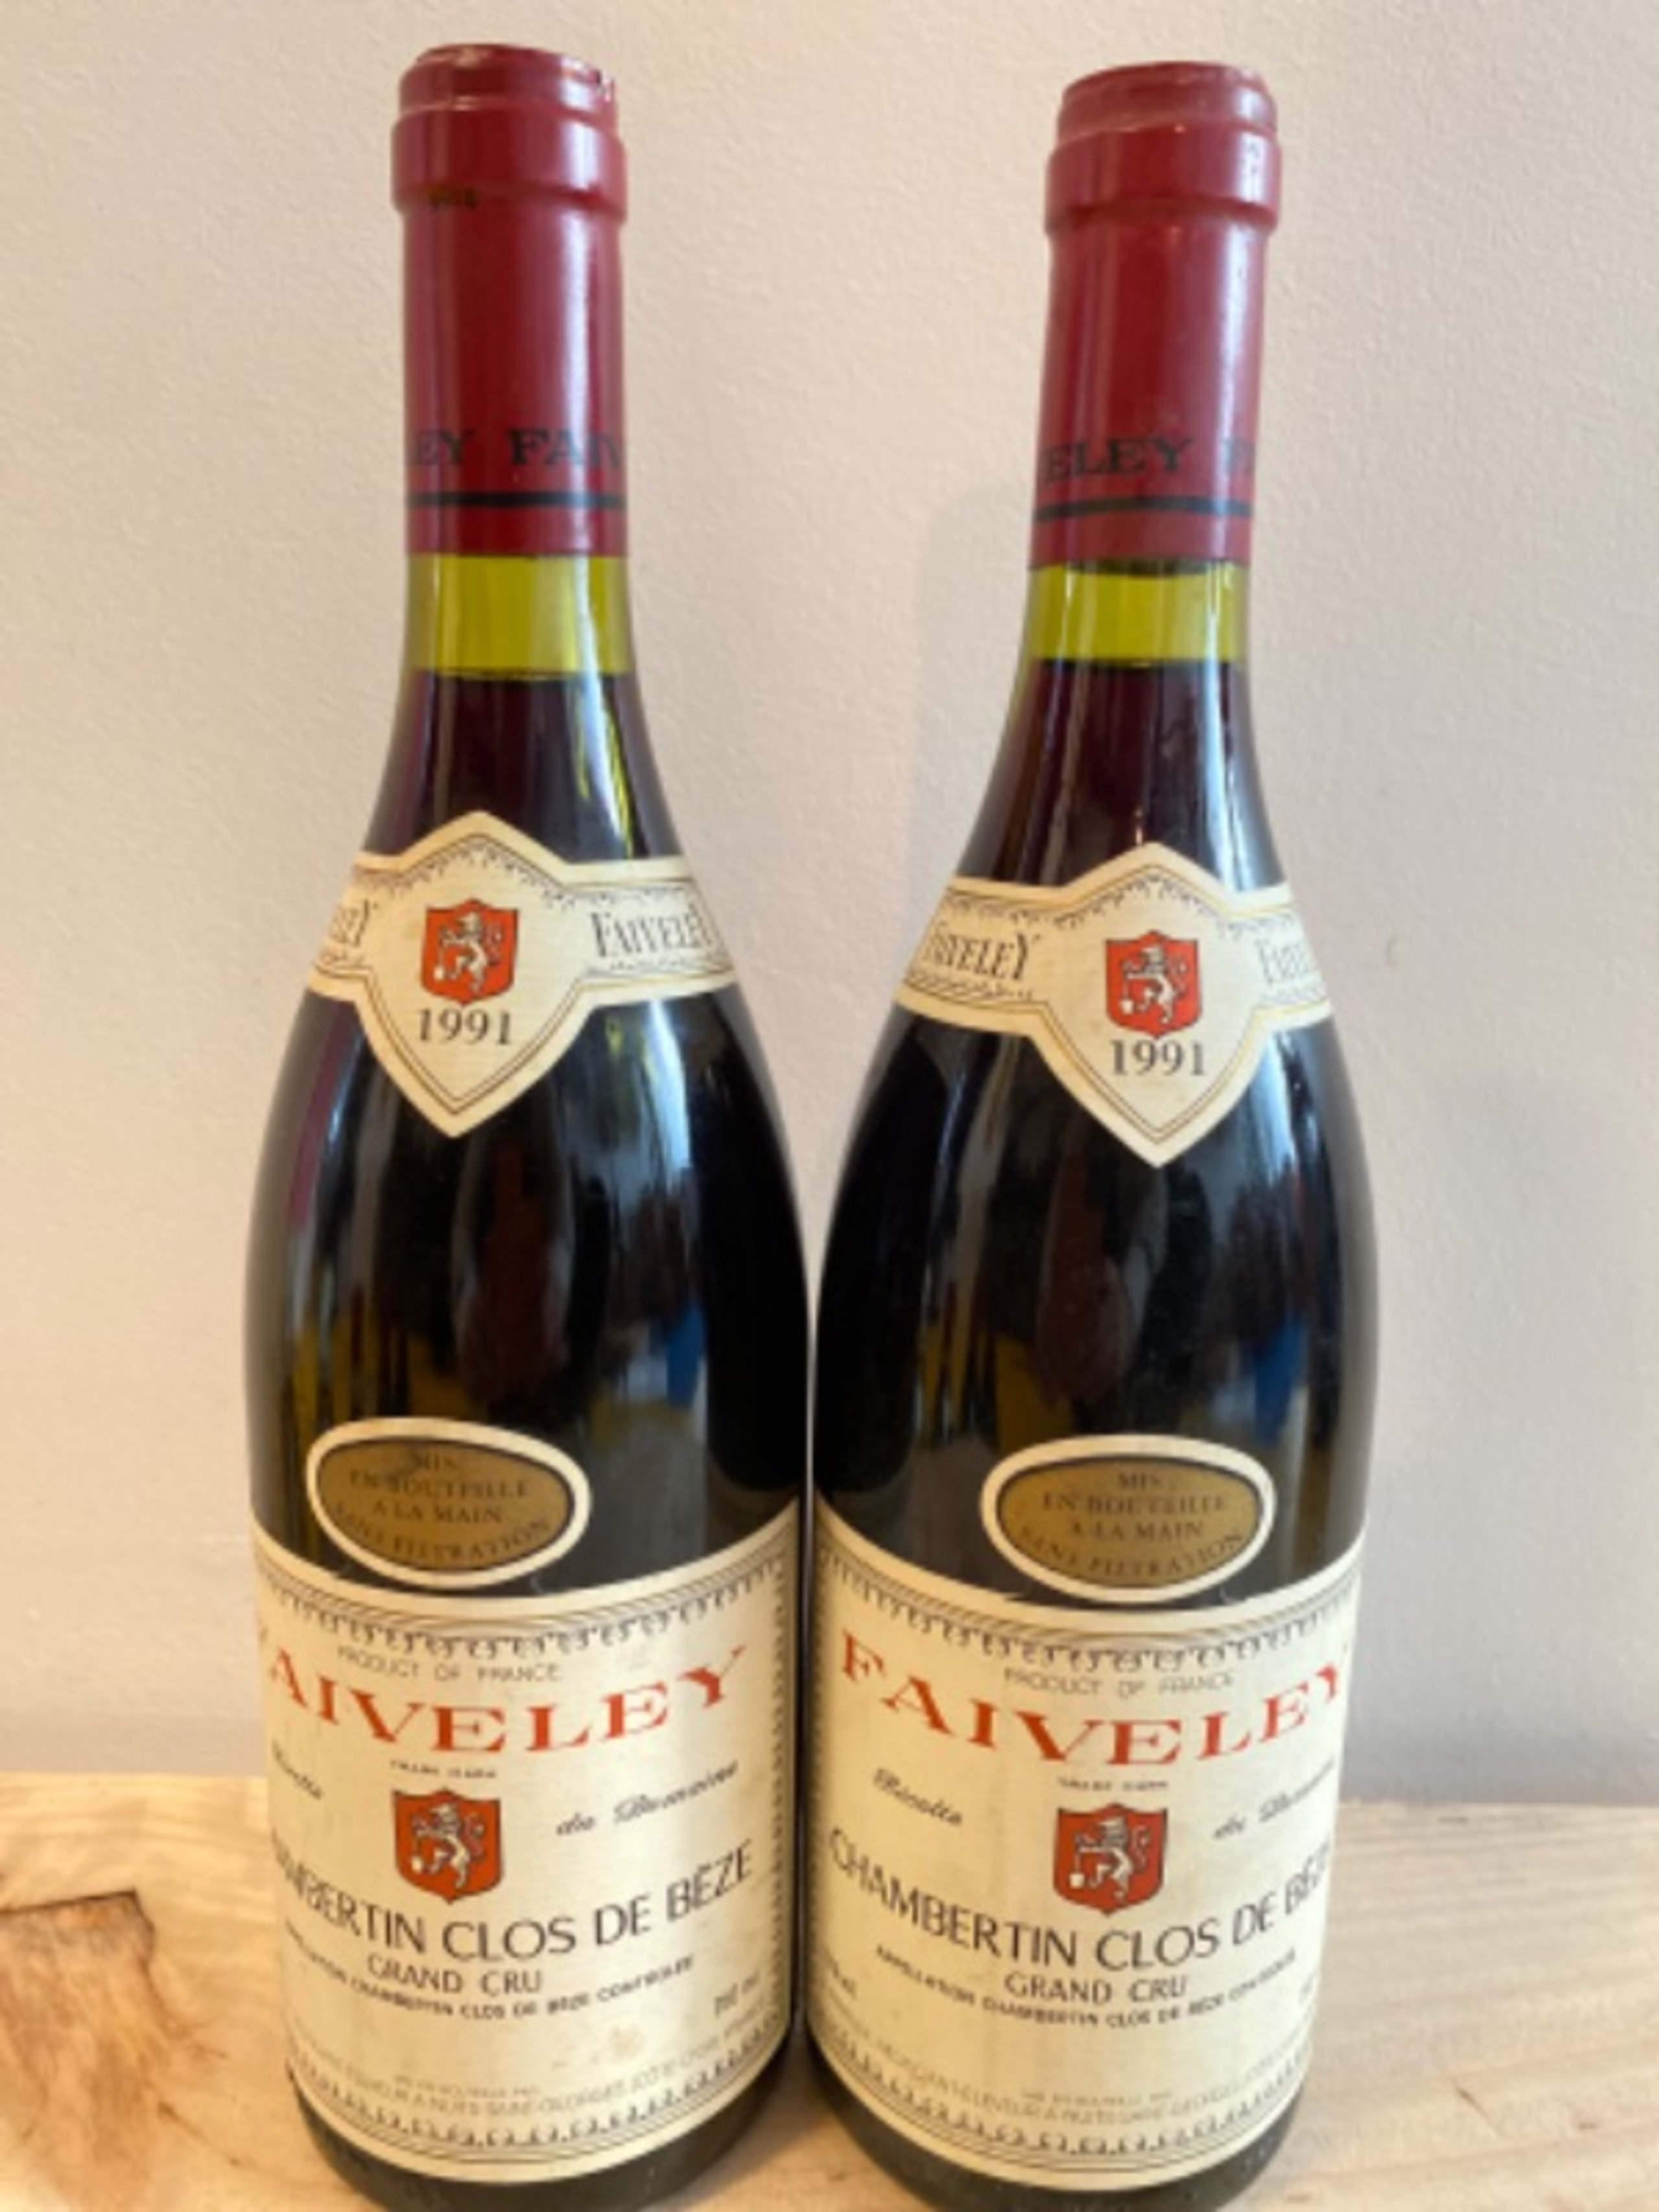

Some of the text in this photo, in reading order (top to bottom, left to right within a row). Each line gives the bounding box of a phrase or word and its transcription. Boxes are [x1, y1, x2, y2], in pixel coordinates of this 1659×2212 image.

[418, 1007, 513, 1046] 1991
[1109, 1038, 1209, 1077] 1991
[1118, 1472, 1161, 1489] MIS
[434, 1504, 502, 1524] MAIN
[1042, 1492, 1076, 1511] EN
[1095, 1522, 1125, 1541] LA
[1134, 1521, 1205, 1543] MAIN
[337, 1645, 560, 1682] PRODUCT OF FRANCE
[268, 1644, 747, 1754] AIVELEY
[1004, 1667, 1234, 1699] PRODUCT OF FRANCE
[828, 1826, 1078, 1968] CHAMBERTIN
[1094, 1917, 1221, 1973] CLOS
[1233, 1890, 1278, 1947] DE
[441, 1915, 576, 1964] CLOS
[594, 1893, 651, 1947] DE
[367, 1952, 542, 1997] GRAND CRU
[1004, 1970, 1189, 2008] GRAND CRU
